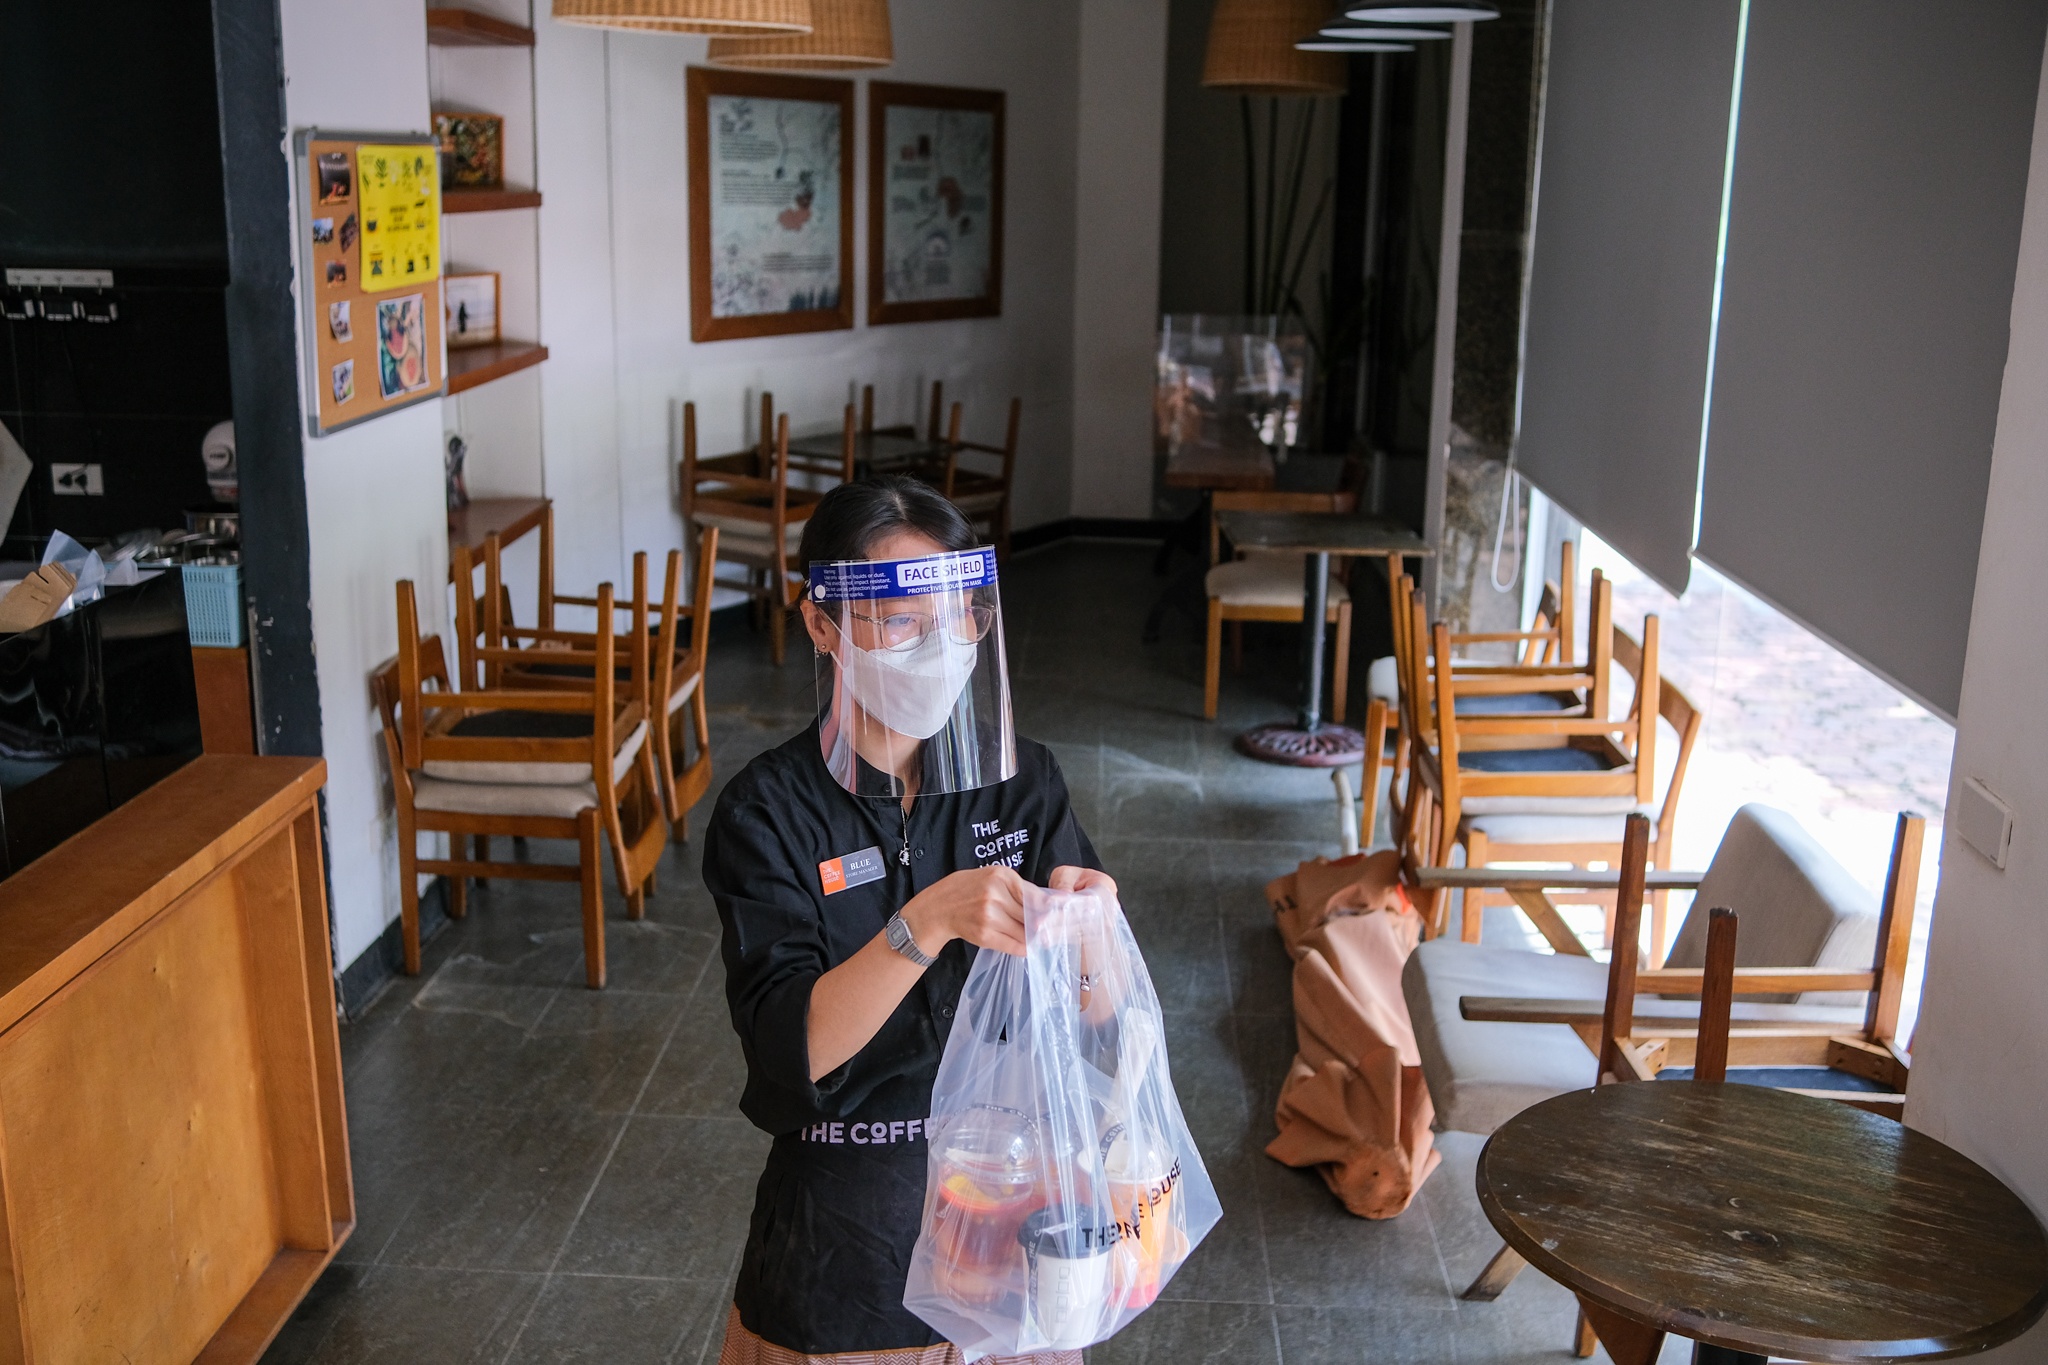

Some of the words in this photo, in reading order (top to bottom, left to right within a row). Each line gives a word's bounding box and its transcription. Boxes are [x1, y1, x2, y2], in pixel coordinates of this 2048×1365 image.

[904, 566, 938, 581] FACE
[942, 560, 982, 576] SHIELD
[907, 585, 942, 594] PROTECTIVE
[972, 819, 1001, 838] THE
[974, 829, 1030, 858] COFFEE
[850, 858, 871, 870] BLUE
[980, 850, 1024, 868] USE
[859, 866, 878, 874] MANAGER
[850, 1118, 930, 1144] COFF
